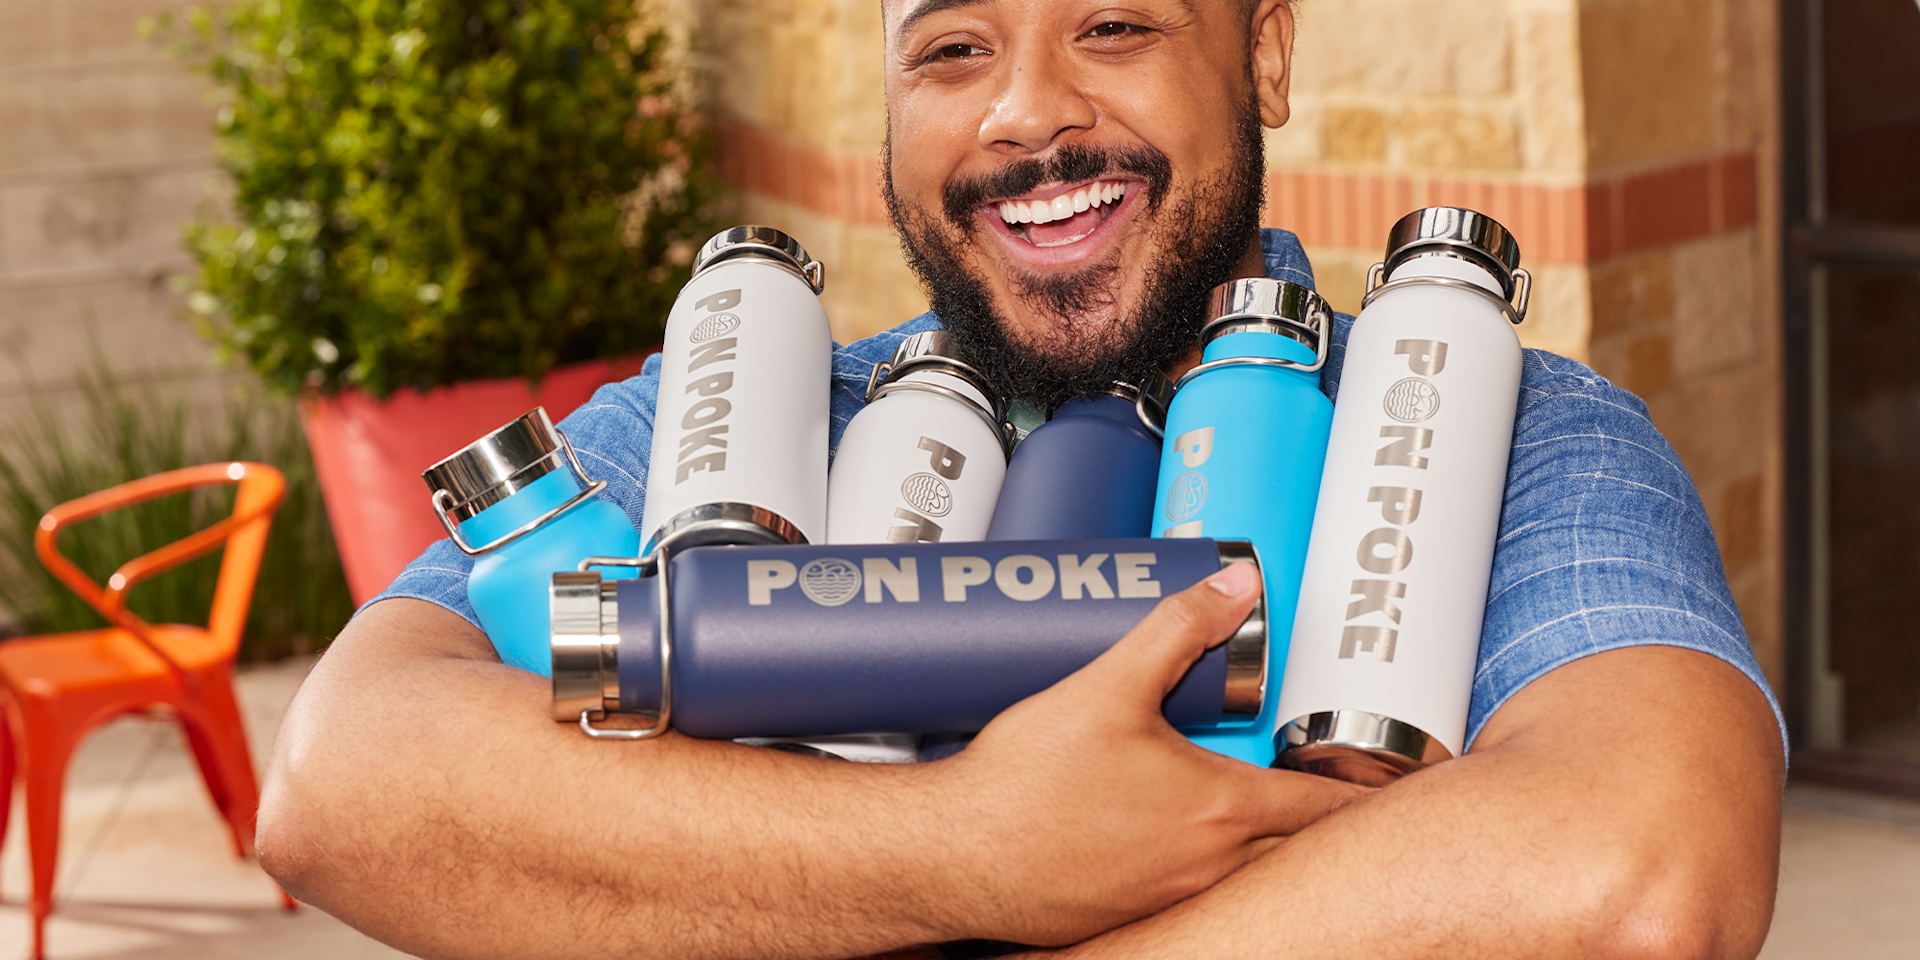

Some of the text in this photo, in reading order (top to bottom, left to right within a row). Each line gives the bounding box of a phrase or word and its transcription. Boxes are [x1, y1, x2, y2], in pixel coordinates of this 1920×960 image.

[674, 288, 742, 486] PON POKE
[747, 552, 1162, 607] PON POKE
[1338, 338, 1449, 664] PON POKE
